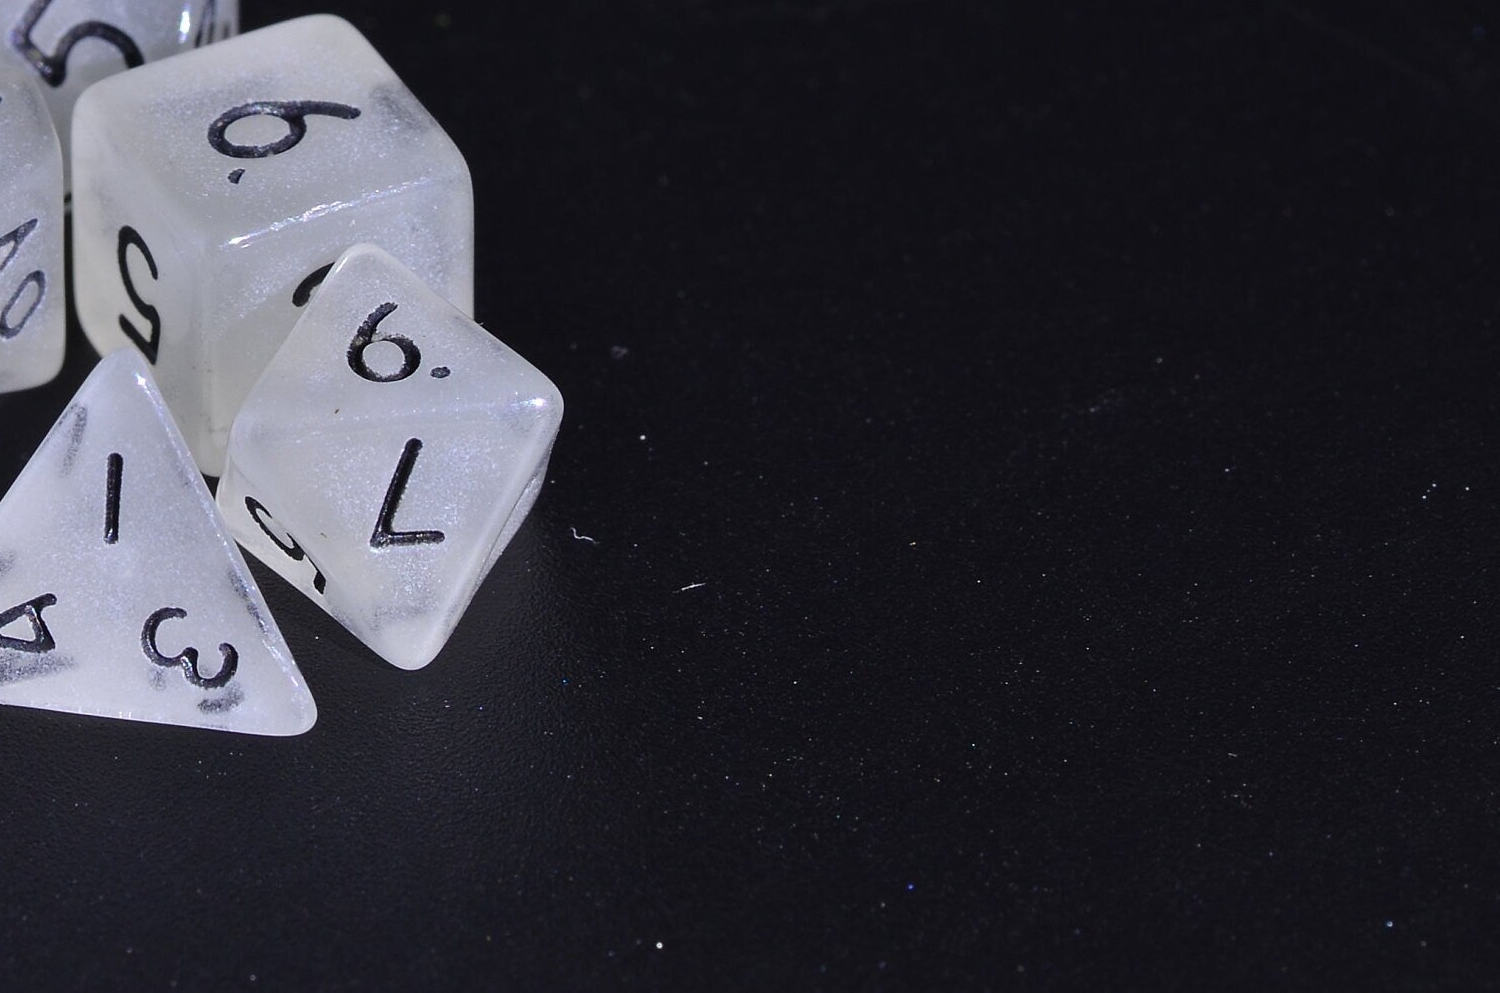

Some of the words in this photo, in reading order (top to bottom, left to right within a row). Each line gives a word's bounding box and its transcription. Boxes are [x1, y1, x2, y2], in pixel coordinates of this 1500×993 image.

[104, 452, 124, 545] 1
[370, 437, 445, 548] 7
[141, 607, 238, 690] 3
